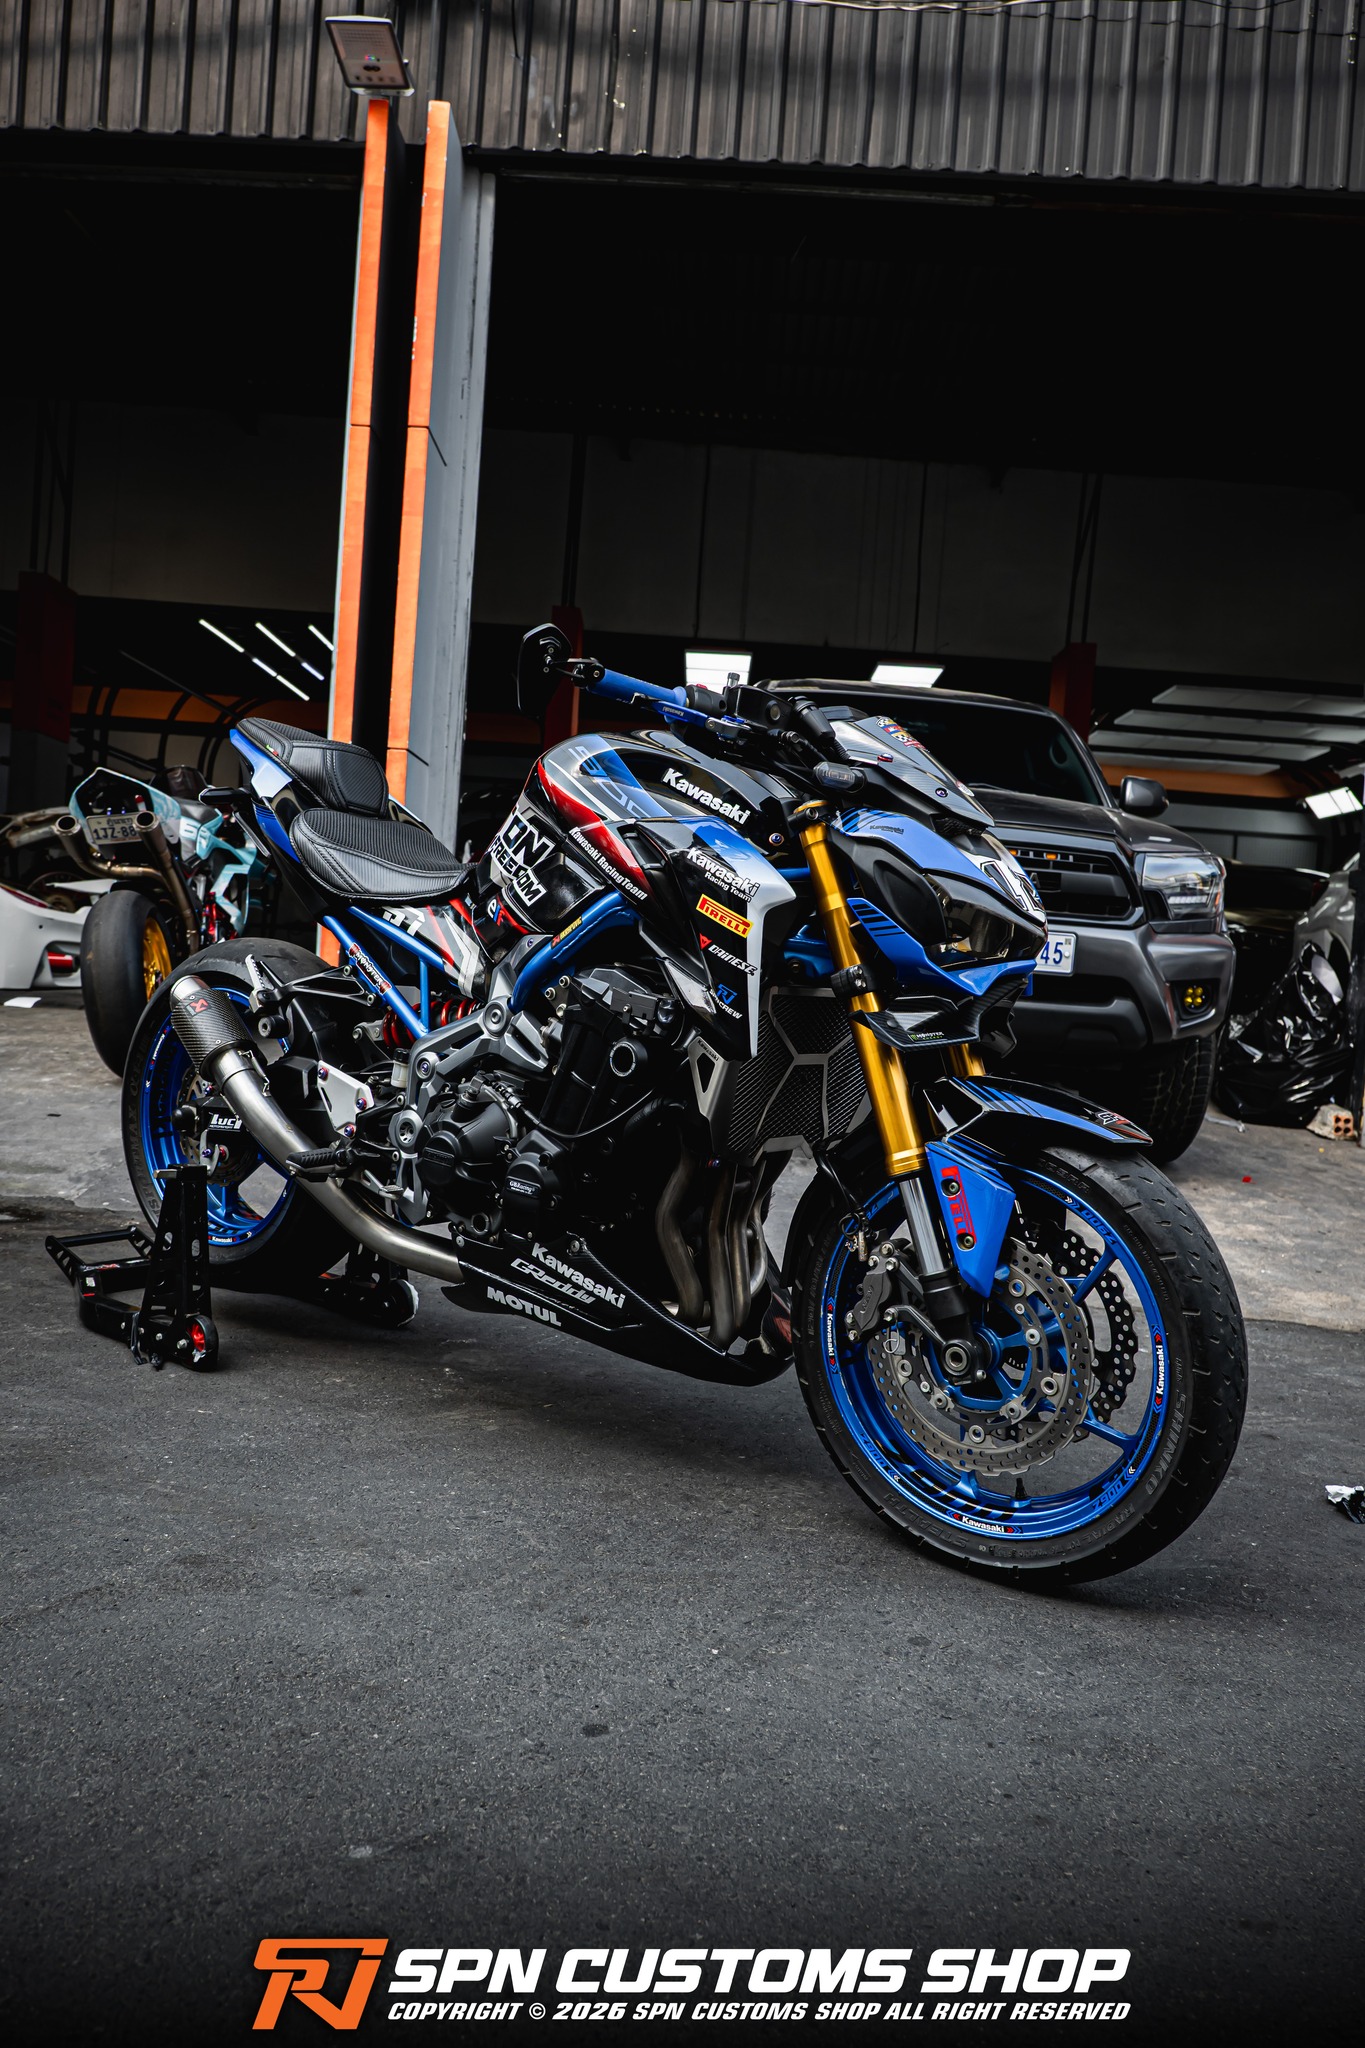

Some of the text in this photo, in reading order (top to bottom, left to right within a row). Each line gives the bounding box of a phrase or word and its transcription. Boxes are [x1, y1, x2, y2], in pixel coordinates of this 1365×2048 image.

[662, 767, 751, 826] Kawasaki
[568, 826, 601, 861] Kawasaki
[686, 847, 761, 898] Kawasaki
[704, 871, 752, 904] Racing Team
[697, 896, 751, 936] PIRELLI
[719, 1002, 743, 1020] CREW
[531, 1242, 627, 1309] Kawasaki
[486, 1285, 562, 1327] MOTUL
[826, 1313, 835, 1356] Kawasaki
[1155, 1344, 1165, 1396] Kawasaki
[1145, 1390, 1188, 1496] SHINKO
[961, 1515, 1005, 1534] Kawasaki
